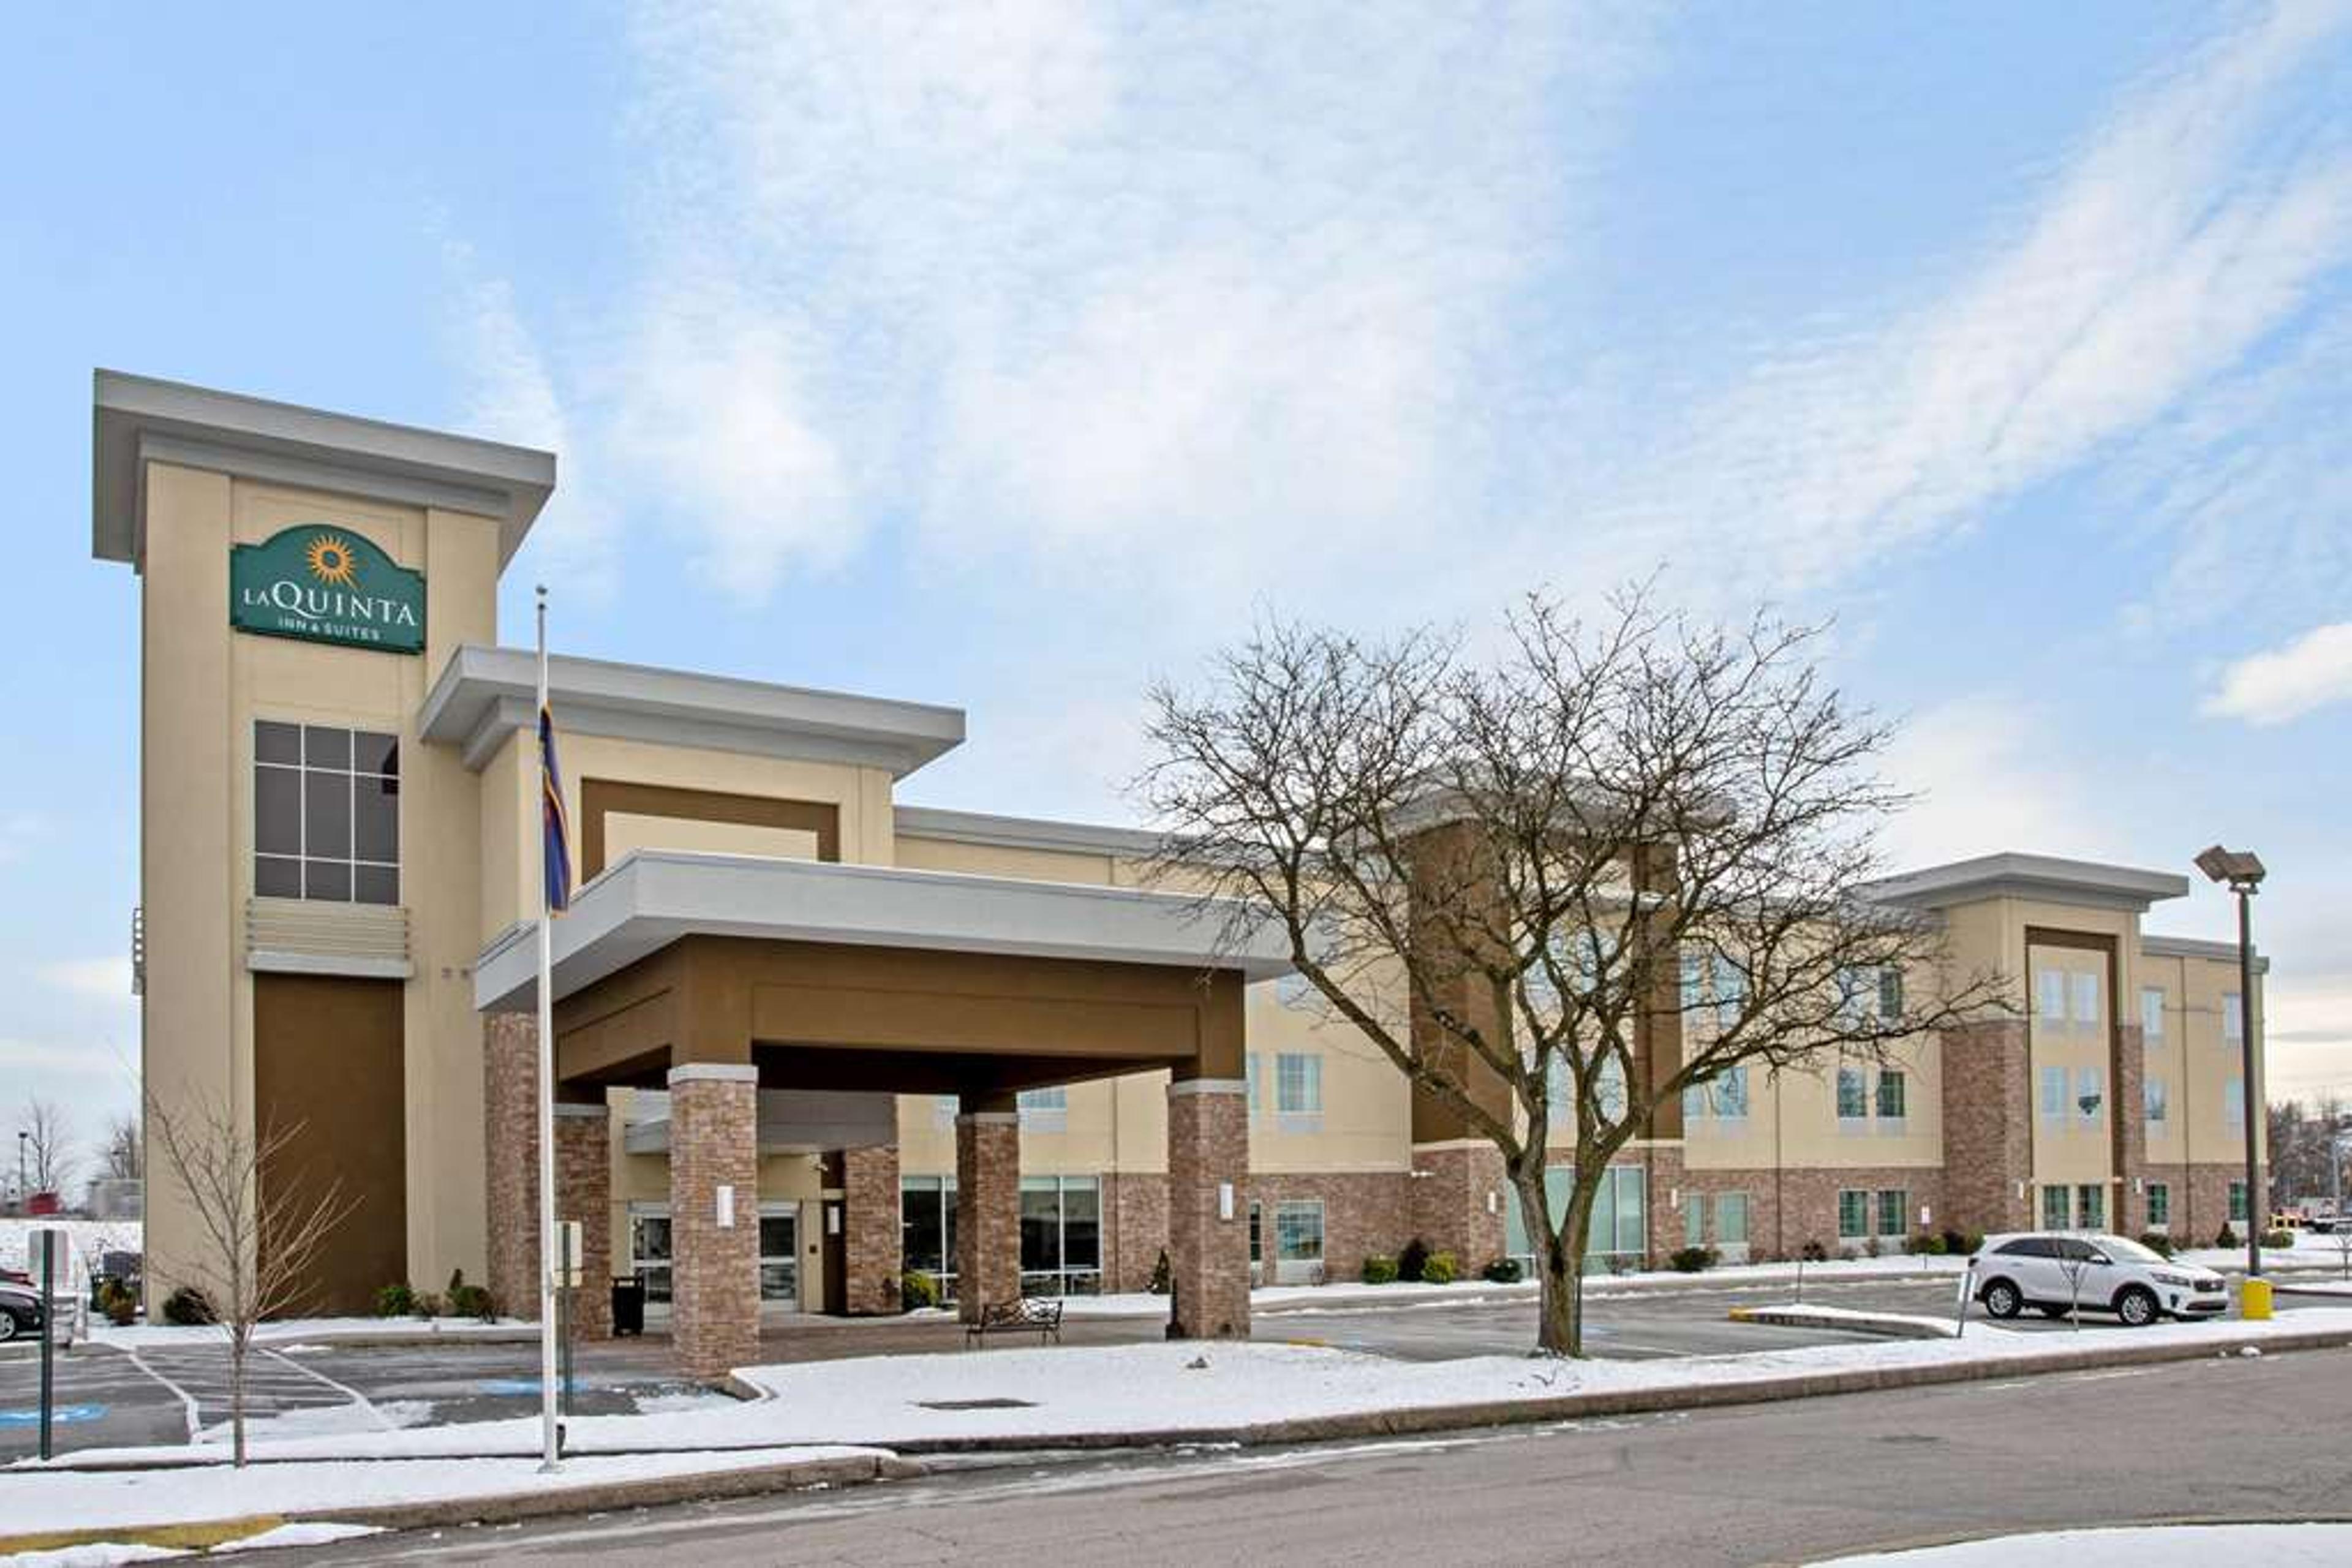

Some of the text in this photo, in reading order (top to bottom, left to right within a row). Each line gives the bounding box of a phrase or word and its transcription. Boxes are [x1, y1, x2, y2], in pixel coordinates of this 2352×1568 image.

[244, 581, 418, 626] LA QUINTA
[277, 616, 306, 631] INN
[323, 622, 380, 641] SUITES
